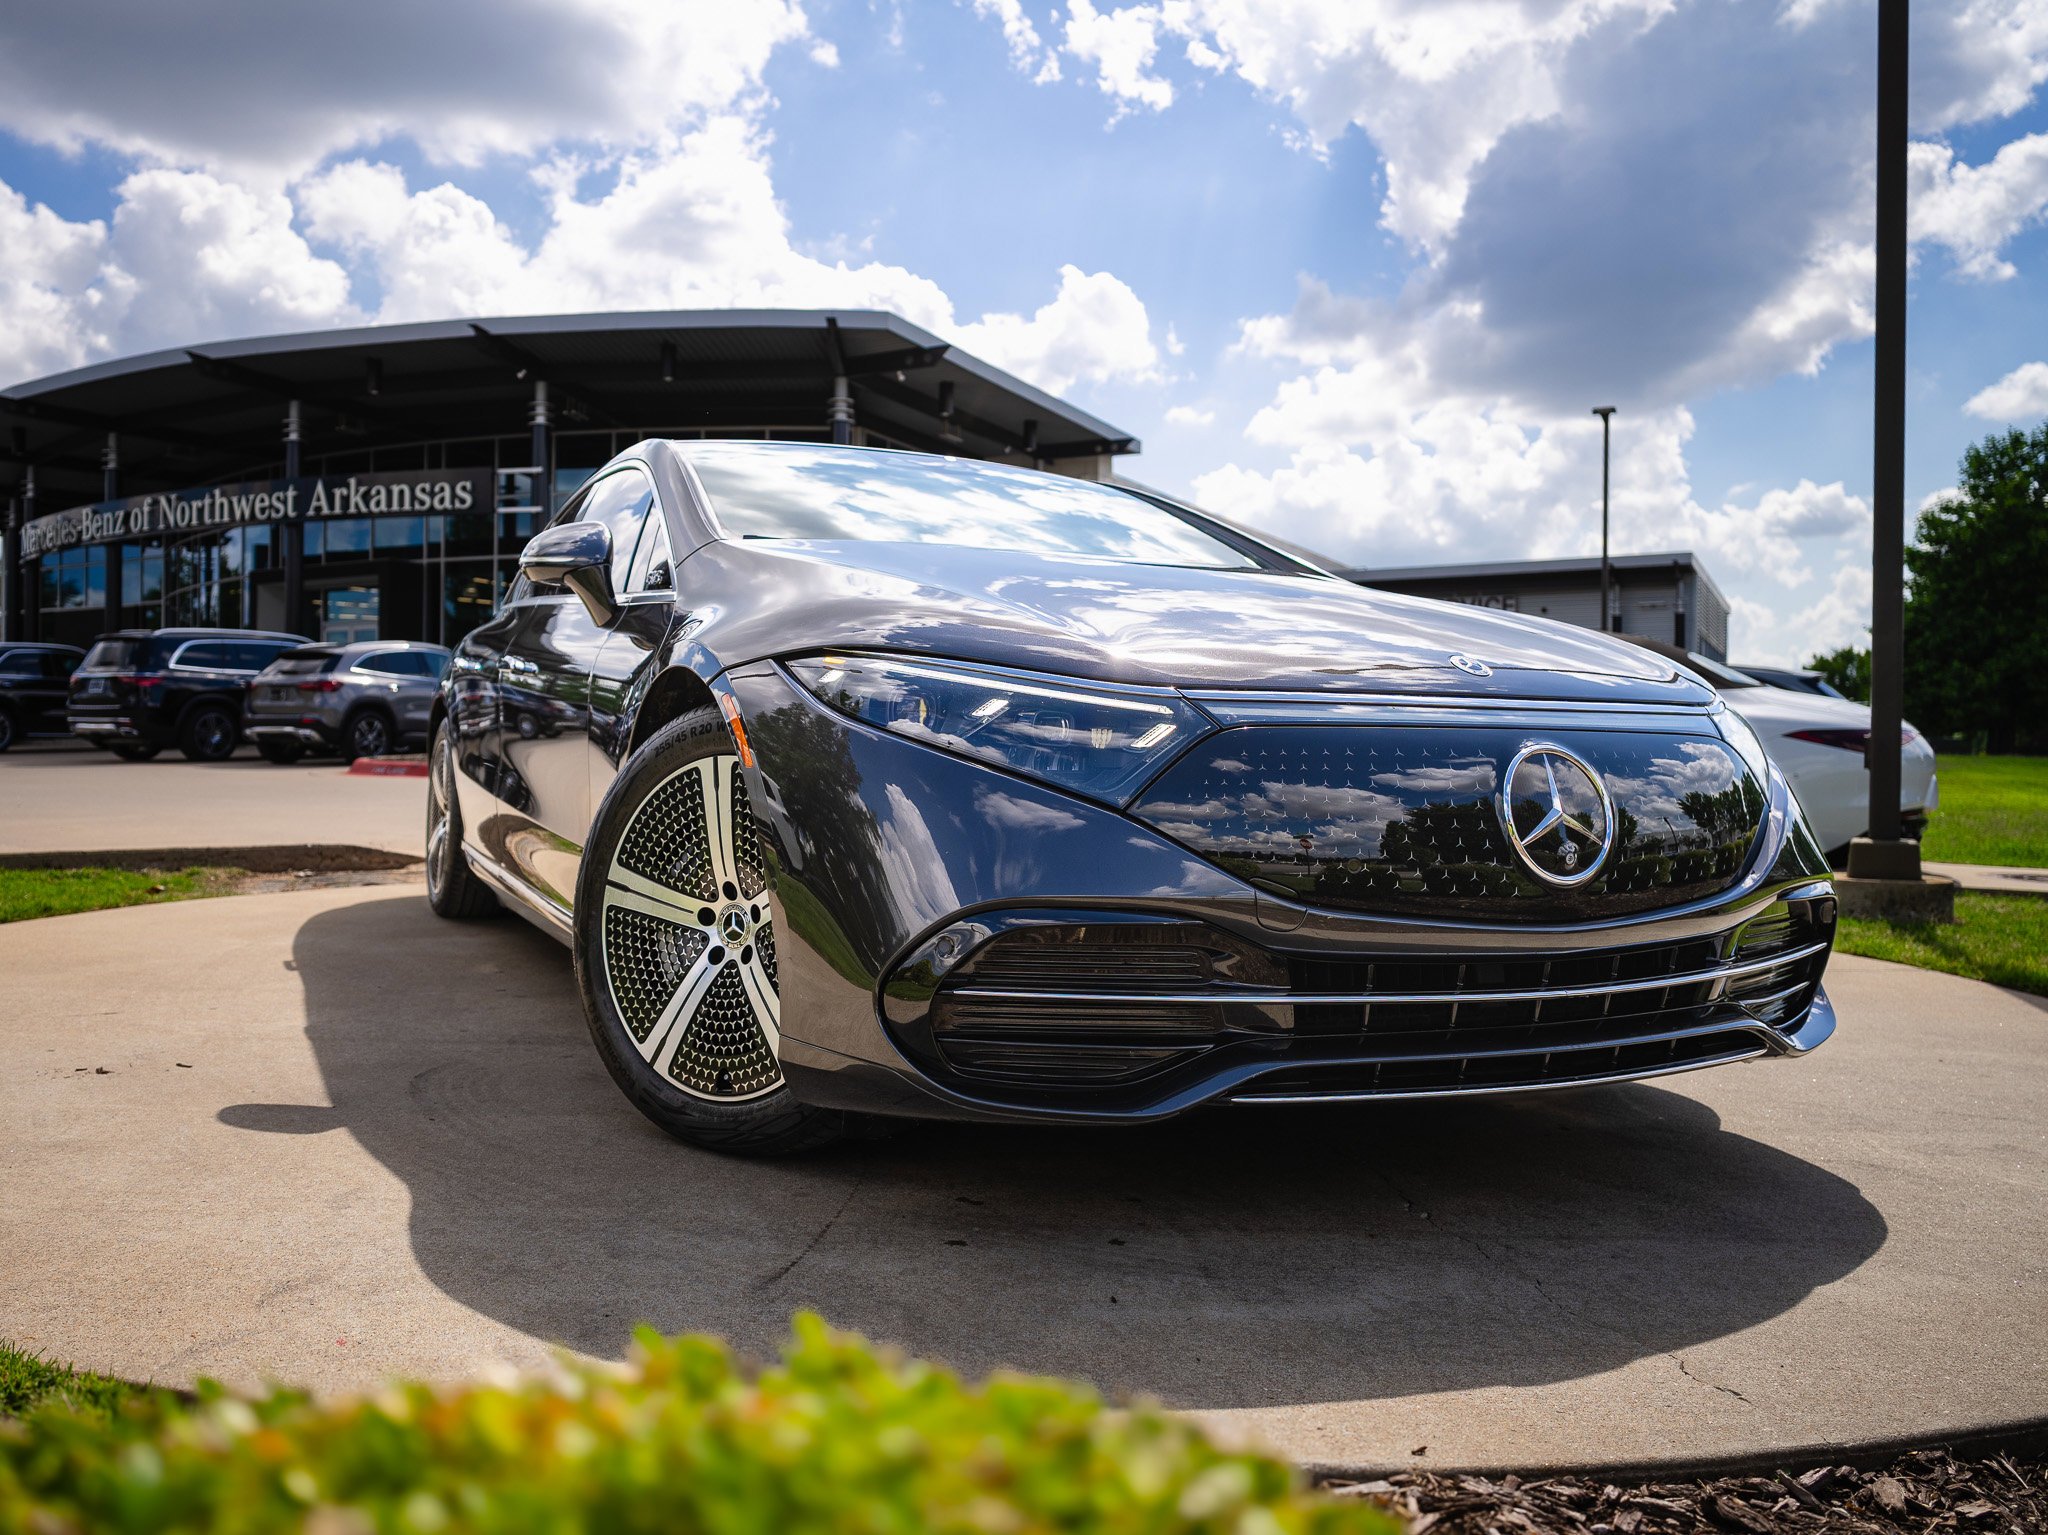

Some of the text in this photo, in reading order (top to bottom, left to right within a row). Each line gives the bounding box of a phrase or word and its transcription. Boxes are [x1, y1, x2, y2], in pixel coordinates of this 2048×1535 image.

[20, 476, 473, 556] Mercedes-Benz of Northwest Arkansas
[655, 731, 687, 758] 255/45
